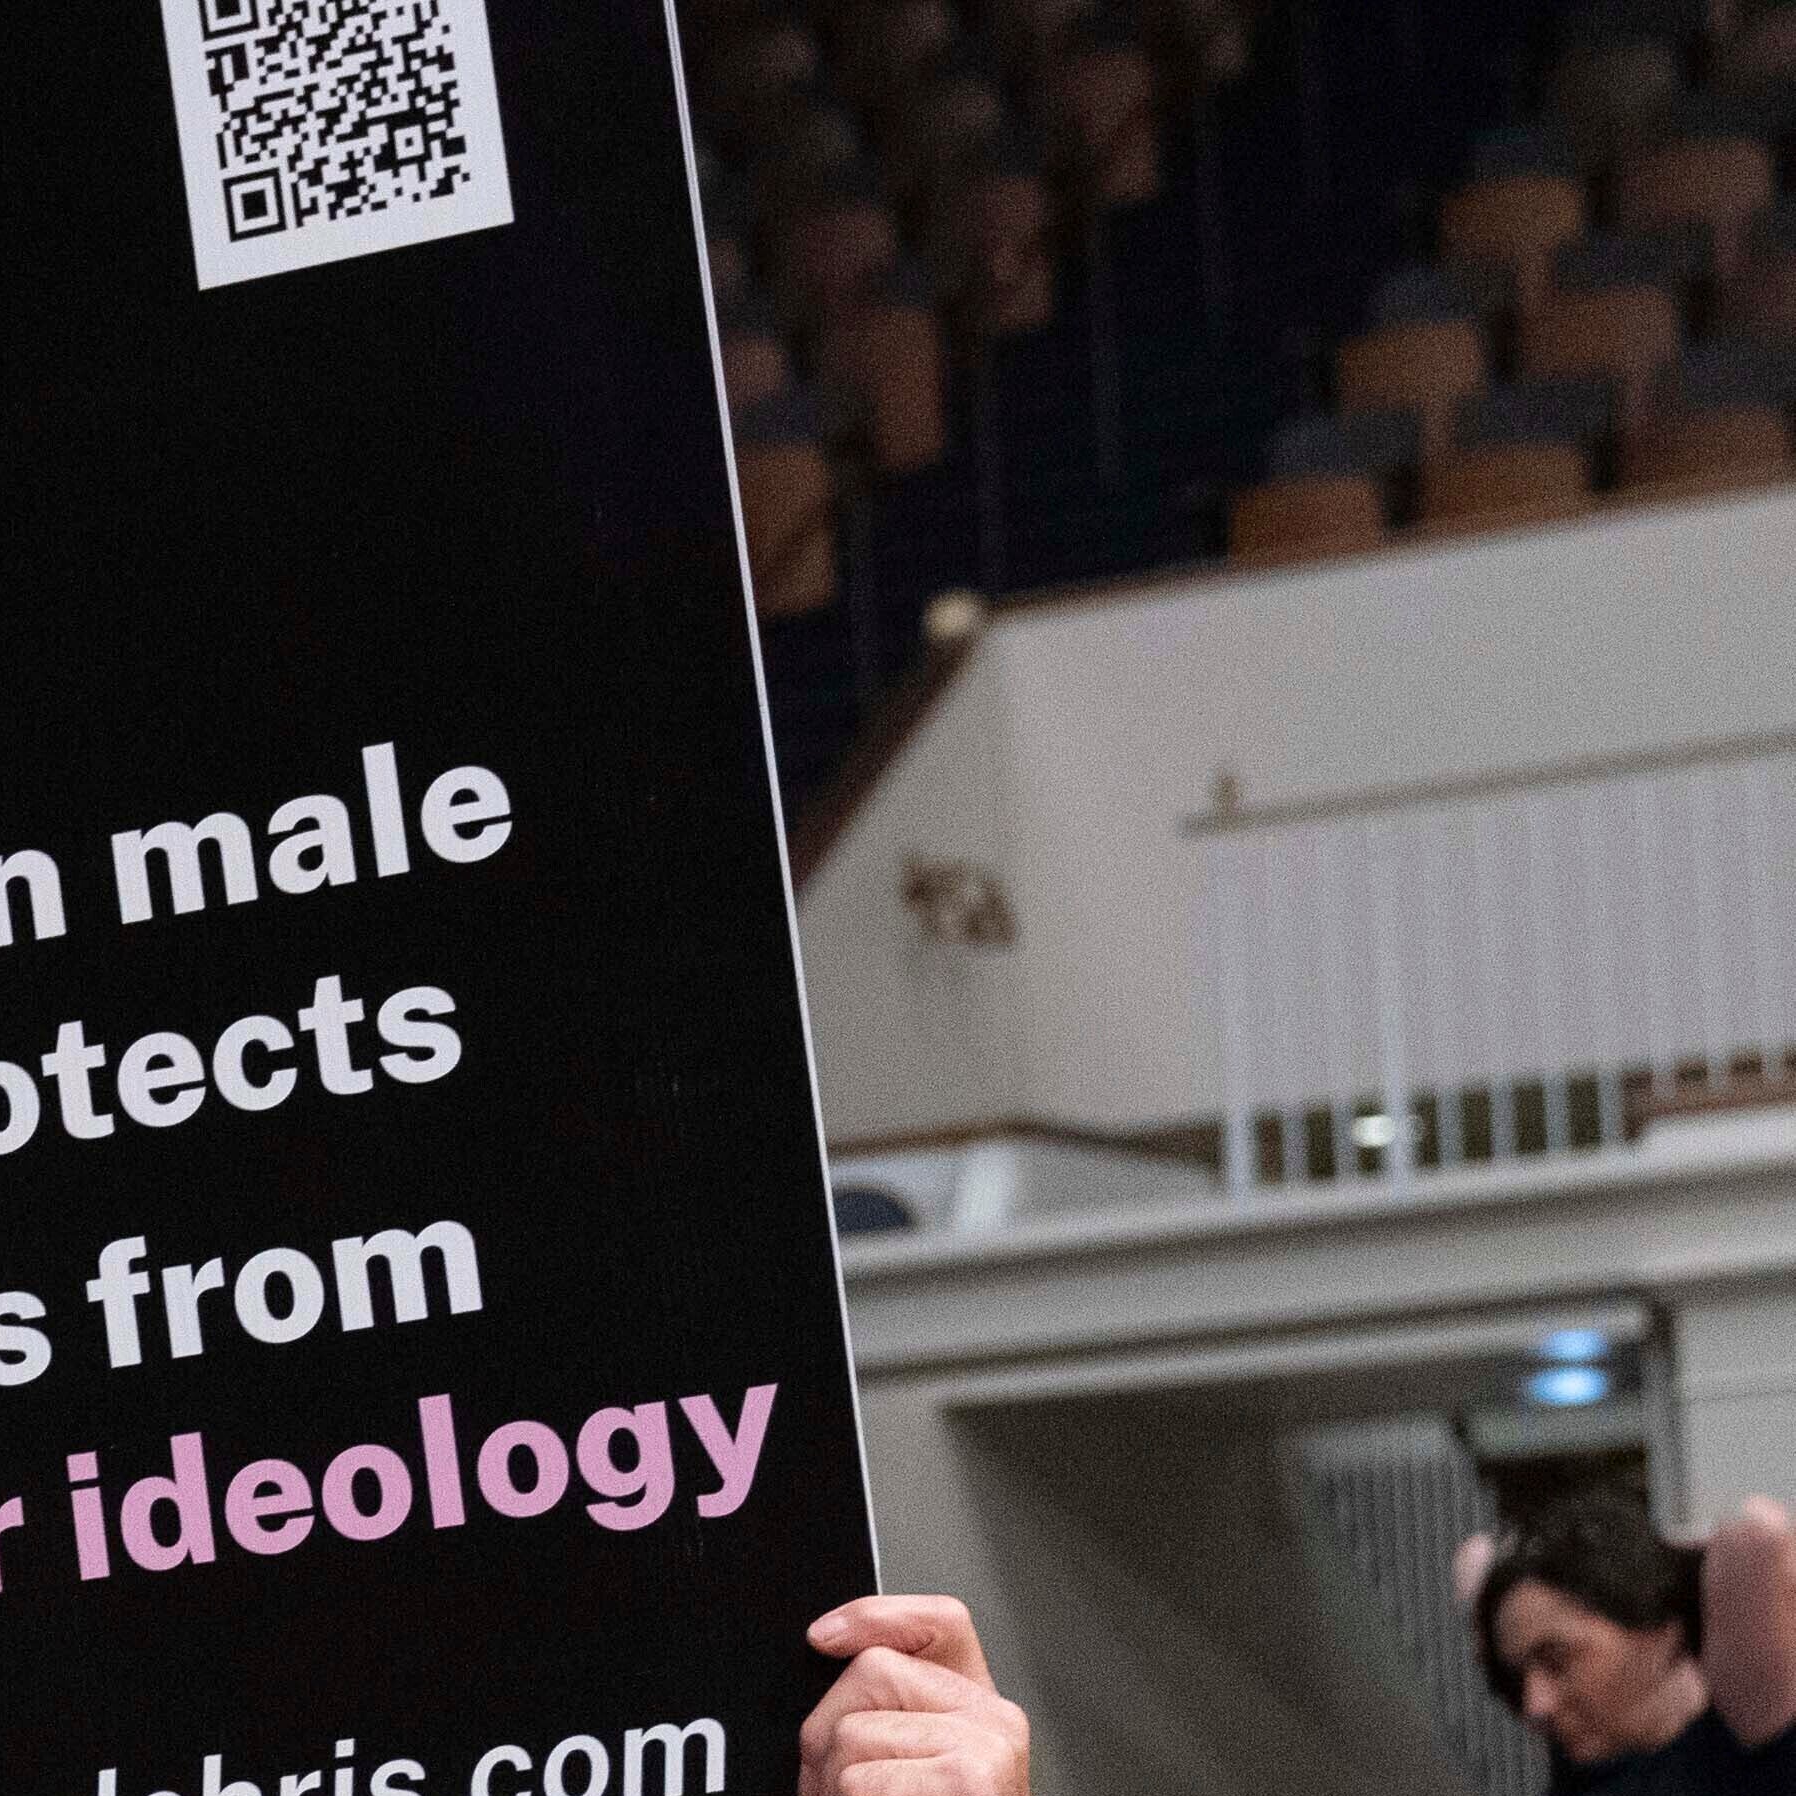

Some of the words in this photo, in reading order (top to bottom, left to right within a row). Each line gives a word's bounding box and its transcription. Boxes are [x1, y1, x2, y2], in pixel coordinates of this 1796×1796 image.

[110, 741, 513, 925] male
[85, 1220, 484, 1369] from
[66, 1383, 778, 1581] ideology
